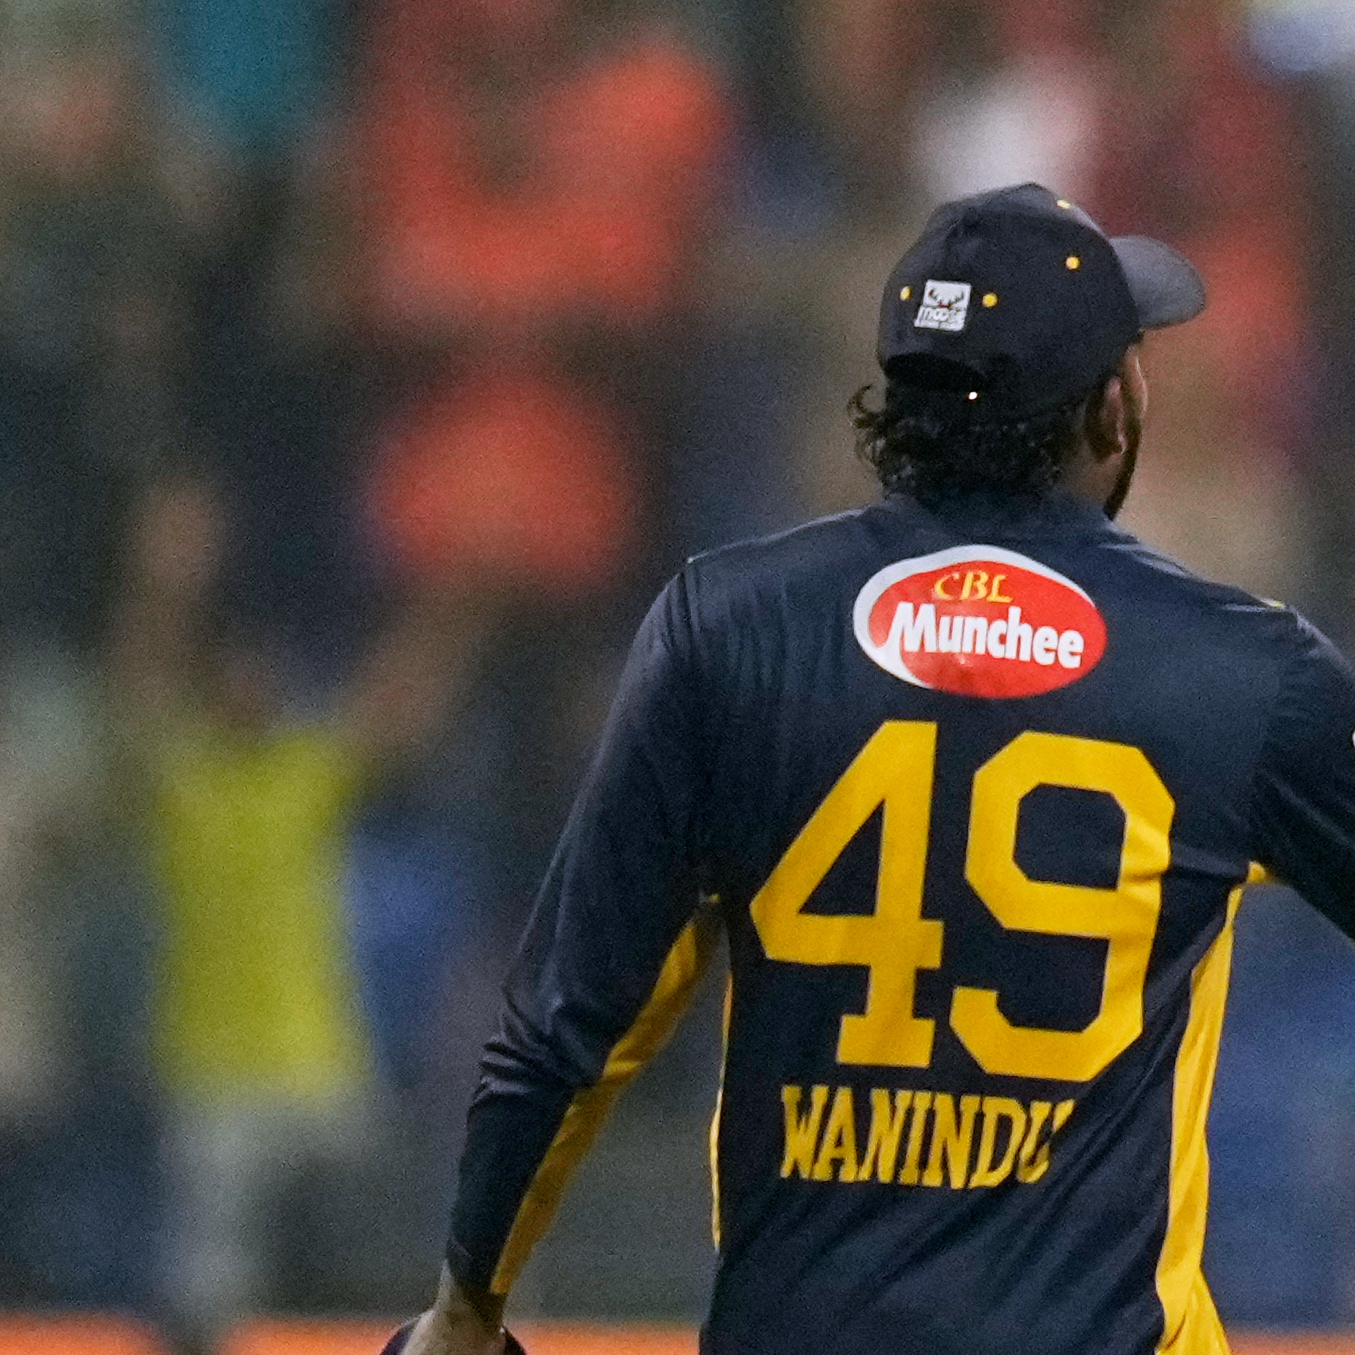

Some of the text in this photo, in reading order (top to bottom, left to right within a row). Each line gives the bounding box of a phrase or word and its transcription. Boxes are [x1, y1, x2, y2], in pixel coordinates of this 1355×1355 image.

[934, 570, 1014, 603] CBL
[886, 602, 1084, 669] Munchee
[749, 719, 1176, 1083] 49
